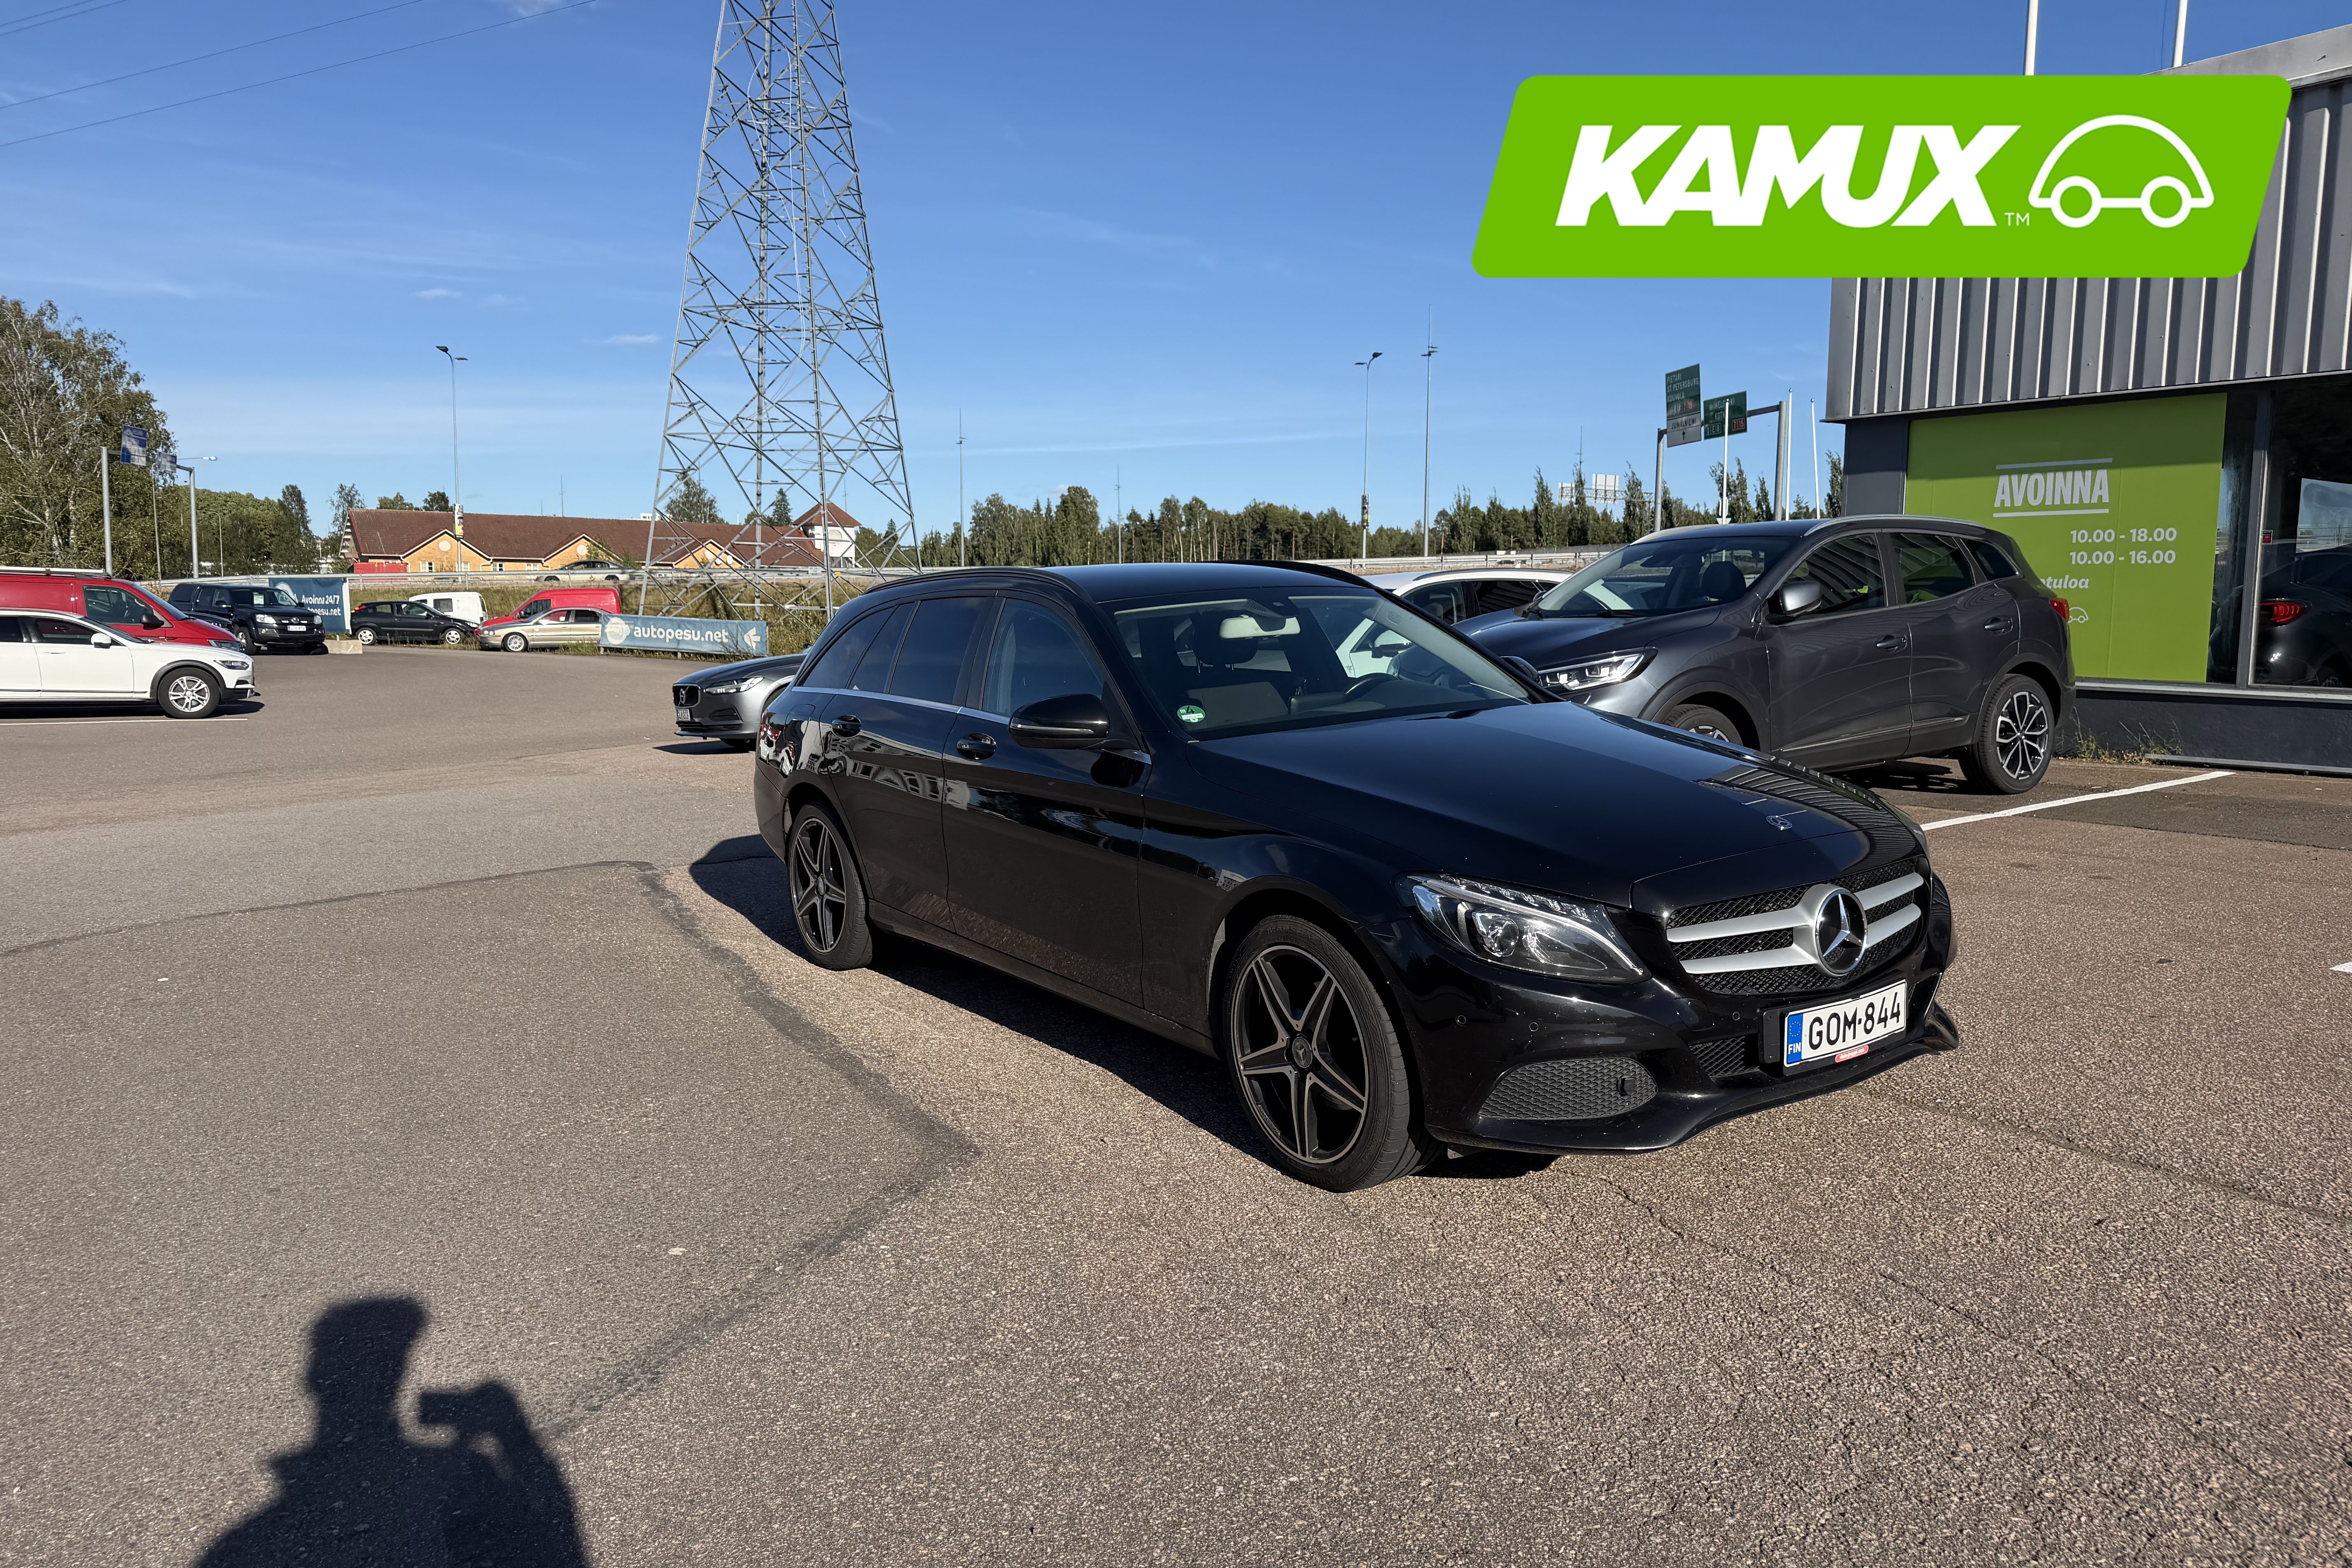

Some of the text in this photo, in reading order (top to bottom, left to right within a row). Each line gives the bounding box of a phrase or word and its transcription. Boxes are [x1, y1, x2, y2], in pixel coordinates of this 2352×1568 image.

[1667, 373, 1682, 383] PIETARI
[1667, 392, 1685, 403] KOUVOLA
[1714, 398, 1735, 409] HELSKI
[1715, 411, 1727, 420] KOTK
[1994, 468, 2109, 508] AVOINNA
[2070, 529, 2115, 543] 10.00
[2130, 527, 2177, 542] 18.00
[2070, 551, 2114, 565] 10.00
[2129, 550, 2176, 564] 16.00
[301, 594, 340, 604] Avoinna 24/7
[634, 625, 728, 643] autopesu.net
[1788, 992, 1901, 1054] FIN GOM-844
